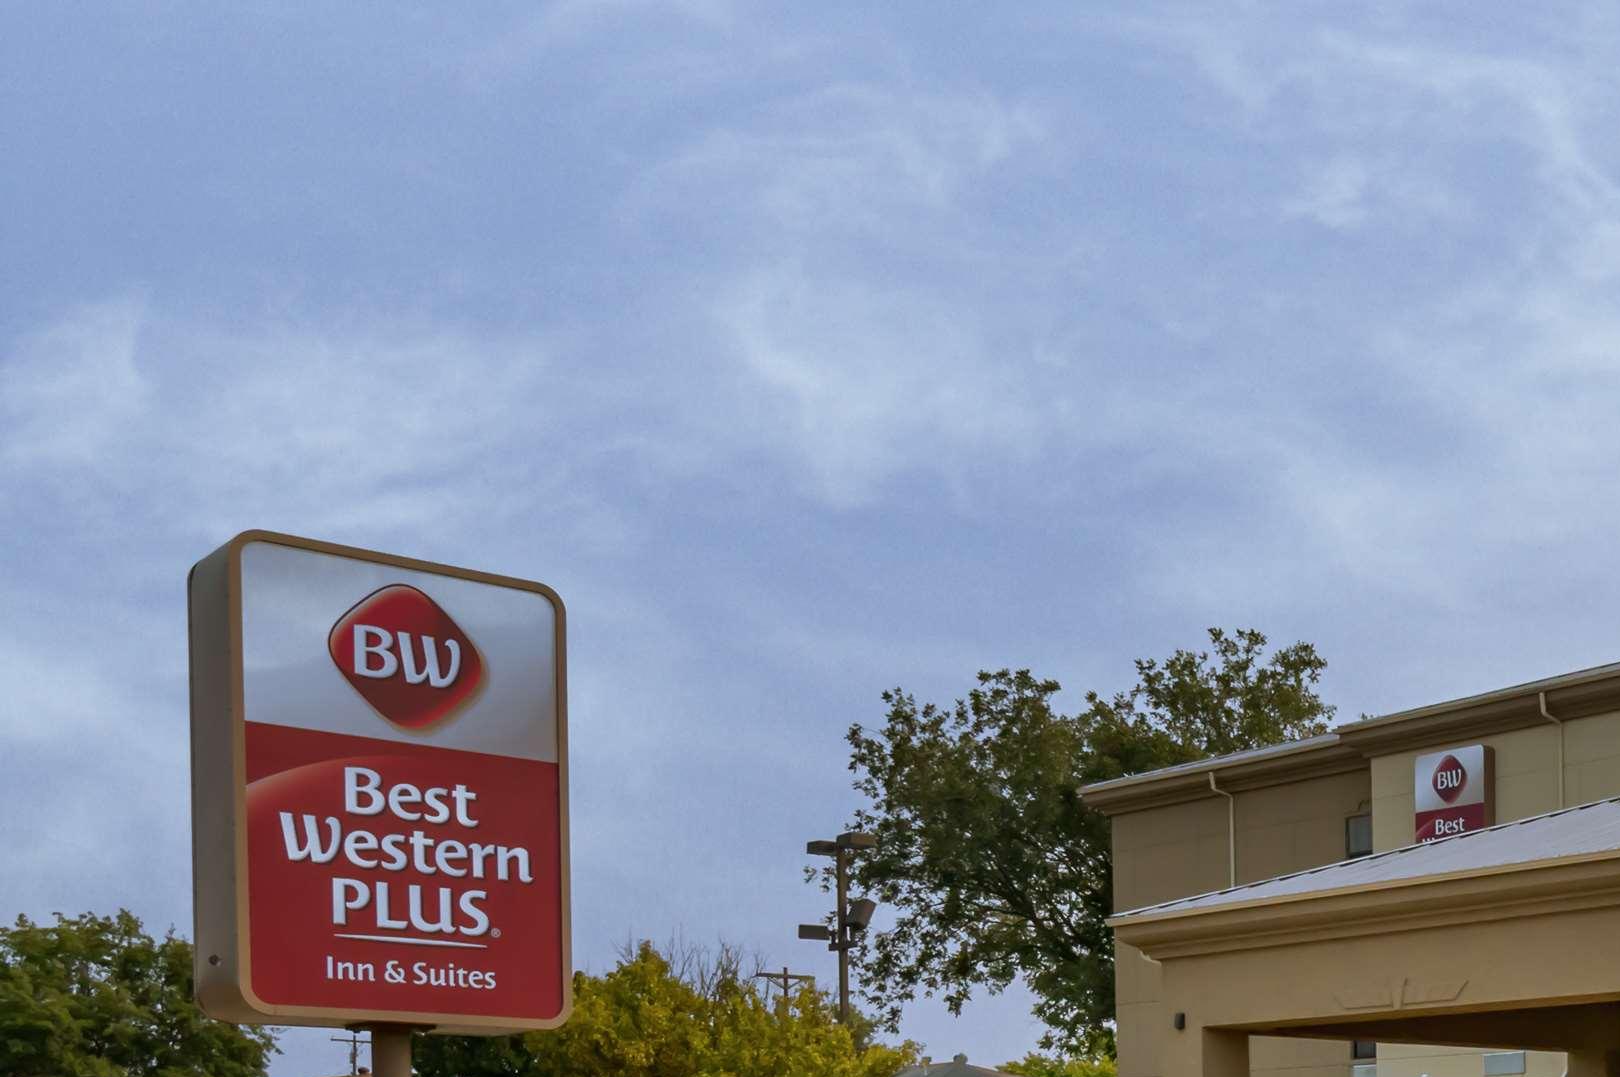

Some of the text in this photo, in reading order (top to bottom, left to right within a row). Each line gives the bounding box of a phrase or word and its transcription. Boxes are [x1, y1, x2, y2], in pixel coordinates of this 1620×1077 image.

[352, 623, 461, 689] BW
[344, 766, 479, 828] Best
[1436, 768, 1462, 790] BW
[279, 811, 534, 884] Western
[1435, 817, 1465, 835] Best
[332, 877, 490, 937] PLUS
[326, 954, 497, 990] Inn & Suites
